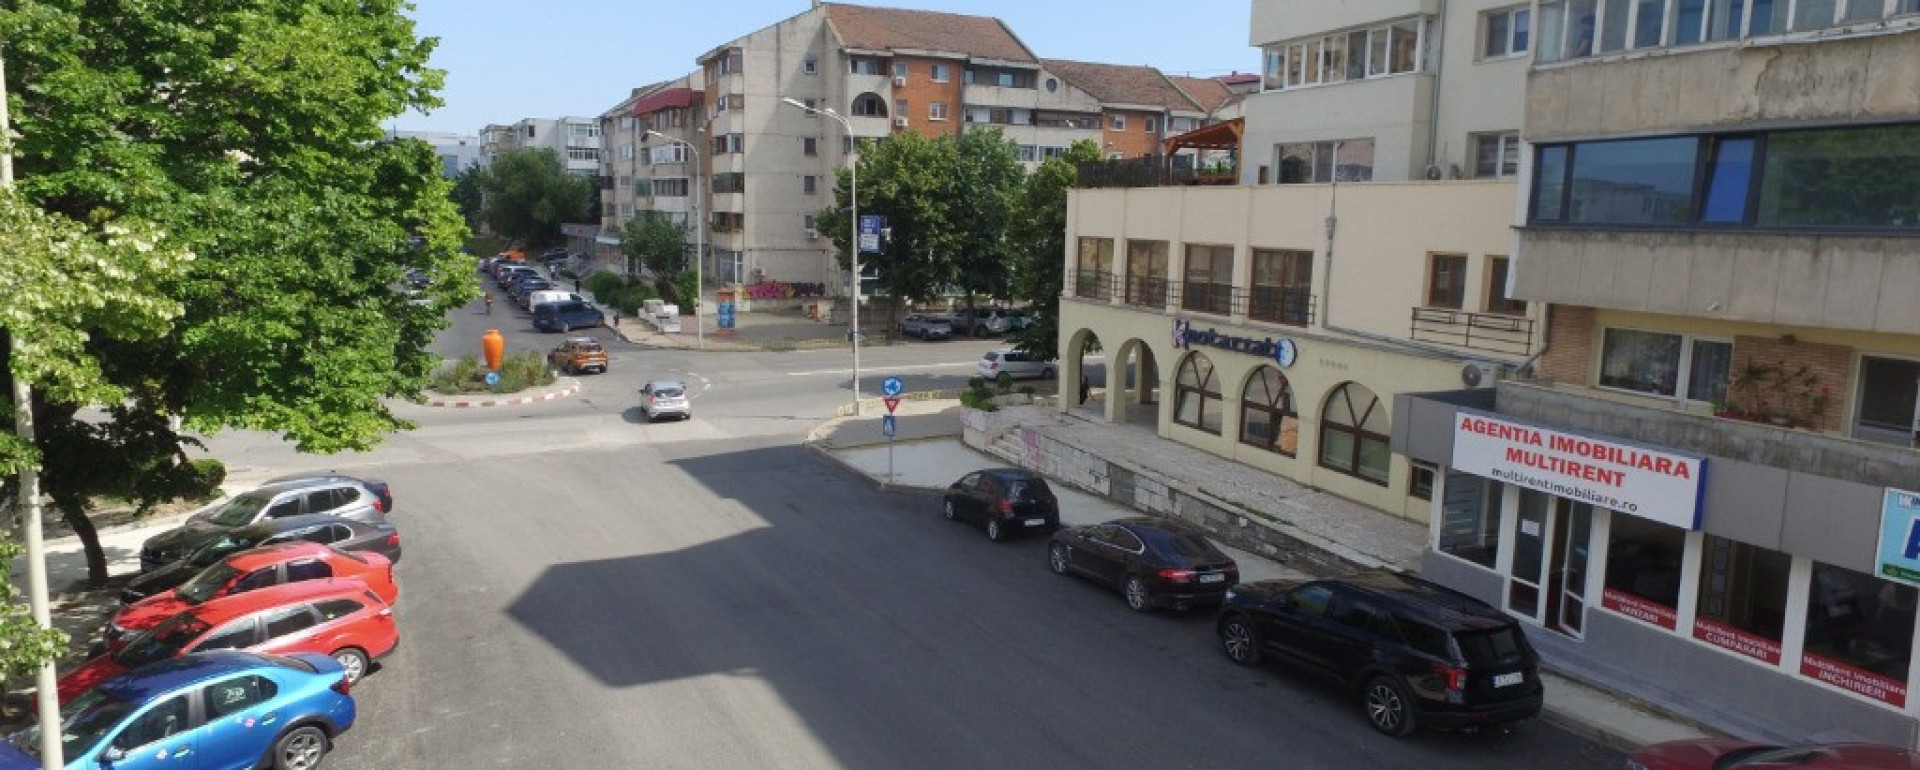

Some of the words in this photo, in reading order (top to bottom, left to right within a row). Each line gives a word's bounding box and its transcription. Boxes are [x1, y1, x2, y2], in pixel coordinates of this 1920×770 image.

[1460, 417, 1543, 447] AGENTIA
[1550, 434, 1690, 479] IMOBILIARA
[1505, 447, 1626, 488] MULTIRENT
[1491, 467, 1638, 513] multirentimobiliare.ro
[1706, 632, 1767, 659] CUMPARARI
[1818, 669, 1886, 699] INCHIRIERI
